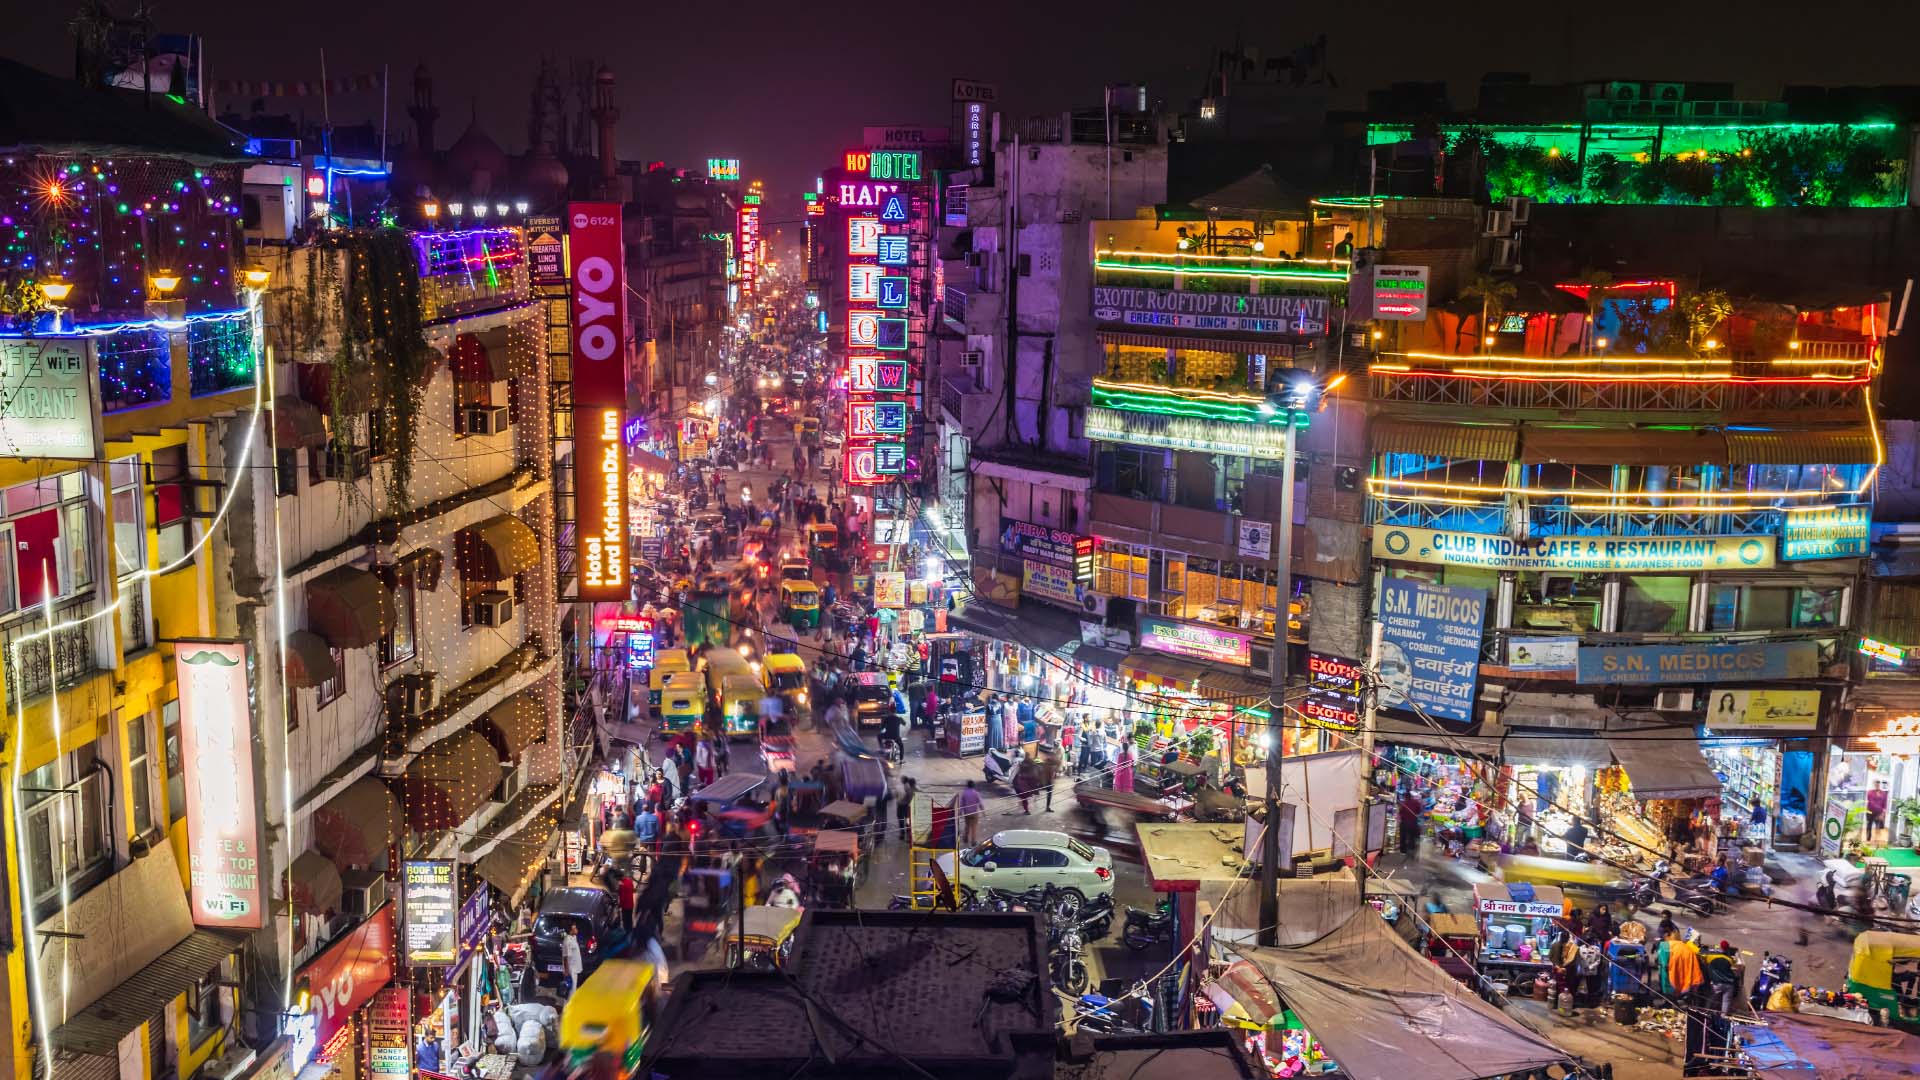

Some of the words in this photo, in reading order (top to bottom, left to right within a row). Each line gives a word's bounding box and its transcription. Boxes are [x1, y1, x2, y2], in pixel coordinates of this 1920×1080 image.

[870, 152, 921, 180] HOTEL
[529, 217, 559, 225] EVEREST
[590, 216, 615, 226] 6124
[532, 245, 561, 253] BREAKFAST
[538, 255, 557, 263] LUNCH
[577, 256, 617, 361] OYO
[1094, 288, 1144, 308] EXOTIC
[1147, 290, 1217, 313] ROOFTOP
[1221, 295, 1327, 319] RESTAURANT
[1131, 312, 1183, 328] BREAKFAST
[1195, 316, 1228, 331] LUNCH
[1241, 319, 1279, 331] DINNER
[602, 410, 617, 441] Inn
[1086, 407, 1123, 431] EXOTIC
[1124, 411, 1172, 435] ROOFTOP
[1015, 521, 1048, 540] HIRA
[1787, 527, 1818, 541] LUNCH
[1831, 526, 1867, 539] DINNER
[1433, 533, 1476, 552] CLUB
[1483, 538, 1530, 556] INDIA
[1536, 540, 1581, 557] CAFE
[1587, 541, 1598, 557] &
[1605, 540, 1716, 558] RESTAURANT
[586, 537, 602, 586] Hotel
[605, 545, 622, 586] Lord
[1026, 560, 1047, 573] HIRA
[1444, 553, 1478, 564] INDIAN
[1487, 557, 1557, 568] CONTINENTAL
[1566, 559, 1611, 569] CHINESE
[1615, 560, 1621, 568] &
[1624, 559, 1674, 569] JAPANESE
[1677, 558, 1703, 568] FOOD
[1385, 588, 1411, 615] S.N.
[1415, 592, 1481, 625] MEDICOS
[1152, 624, 1201, 642] EXOTIC
[1388, 616, 1420, 629] CHEMIST
[1443, 624, 1480, 638] SERGICAL
[1386, 627, 1426, 640] PHARMACY
[1442, 635, 1479, 649] MEDICINE
[1408, 641, 1446, 655] COSMETIC
[1309, 658, 1360, 680] EXOTIC
[1603, 655, 1650, 671] S.N.
[1659, 652, 1765, 671] MEDICOS
[1611, 673, 1649, 681] CHEMIST
[1660, 671, 1707, 680] PHARMACY
[1307, 705, 1357, 723] EXOTIC
[237, 840, 247, 853] &
[230, 857, 256, 871] TOP
[433, 866, 451, 874] TOP
